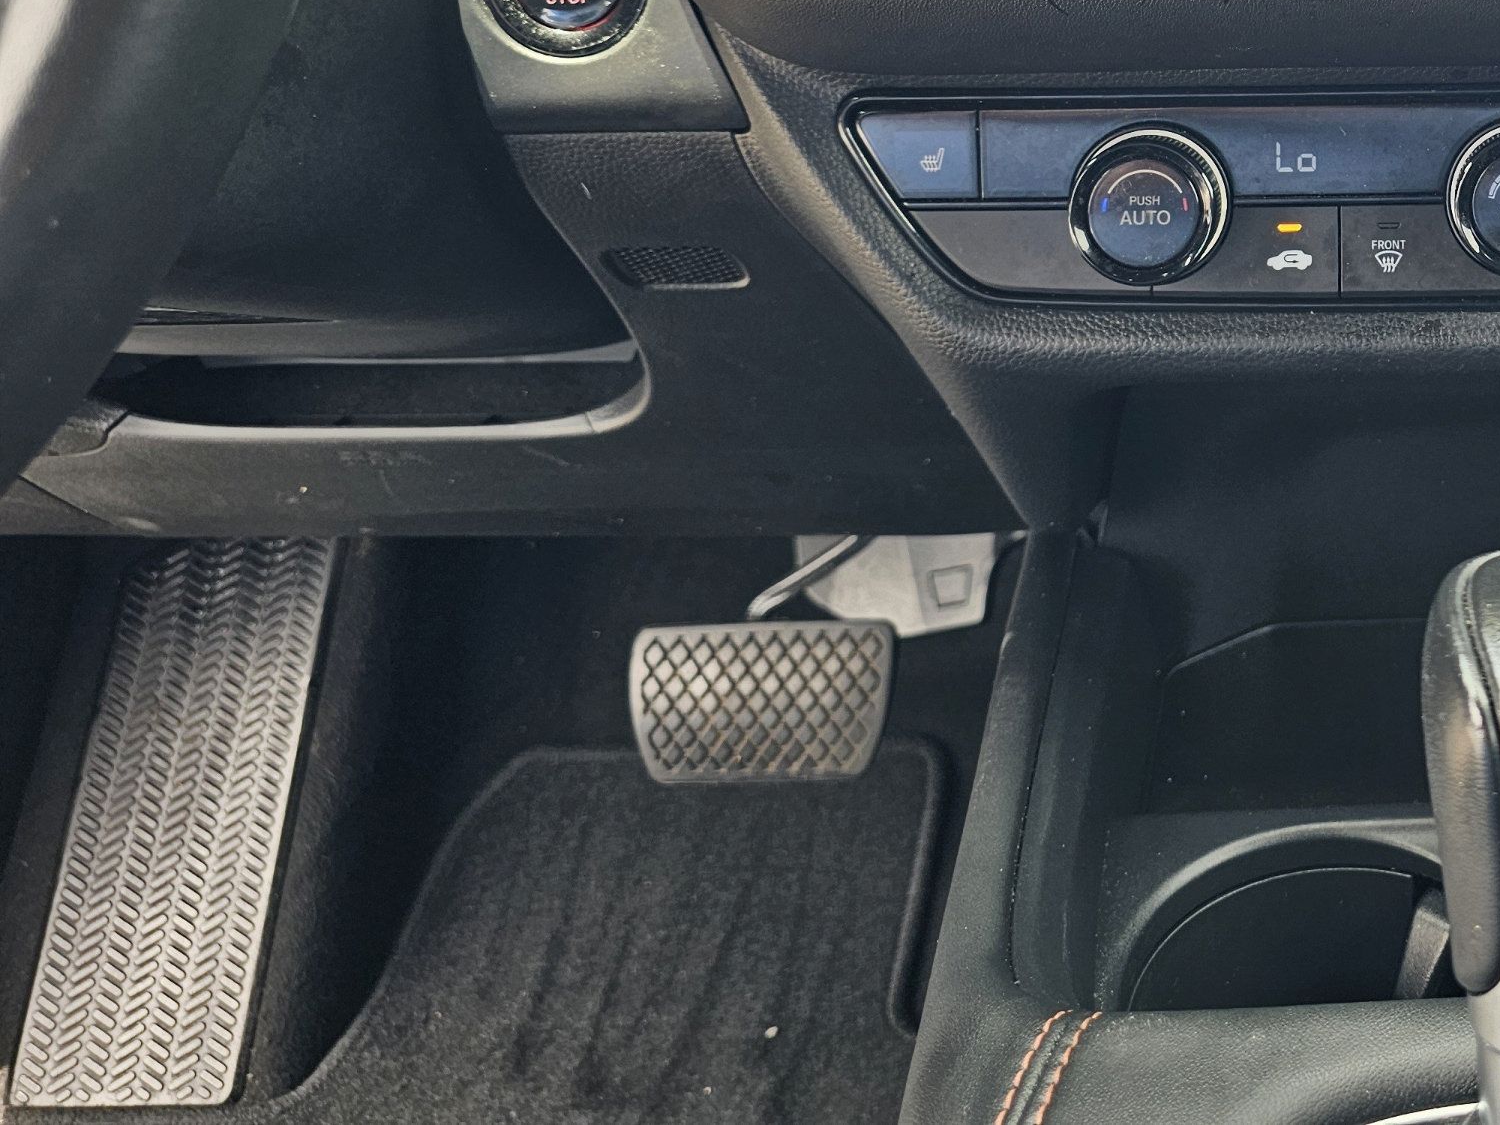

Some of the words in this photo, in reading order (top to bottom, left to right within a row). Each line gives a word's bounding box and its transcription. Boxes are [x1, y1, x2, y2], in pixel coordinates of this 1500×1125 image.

[1130, 196, 1160, 205] PUSH
[1120, 210, 1170, 225] AUTO
[1372, 240, 1406, 251] FRONT
